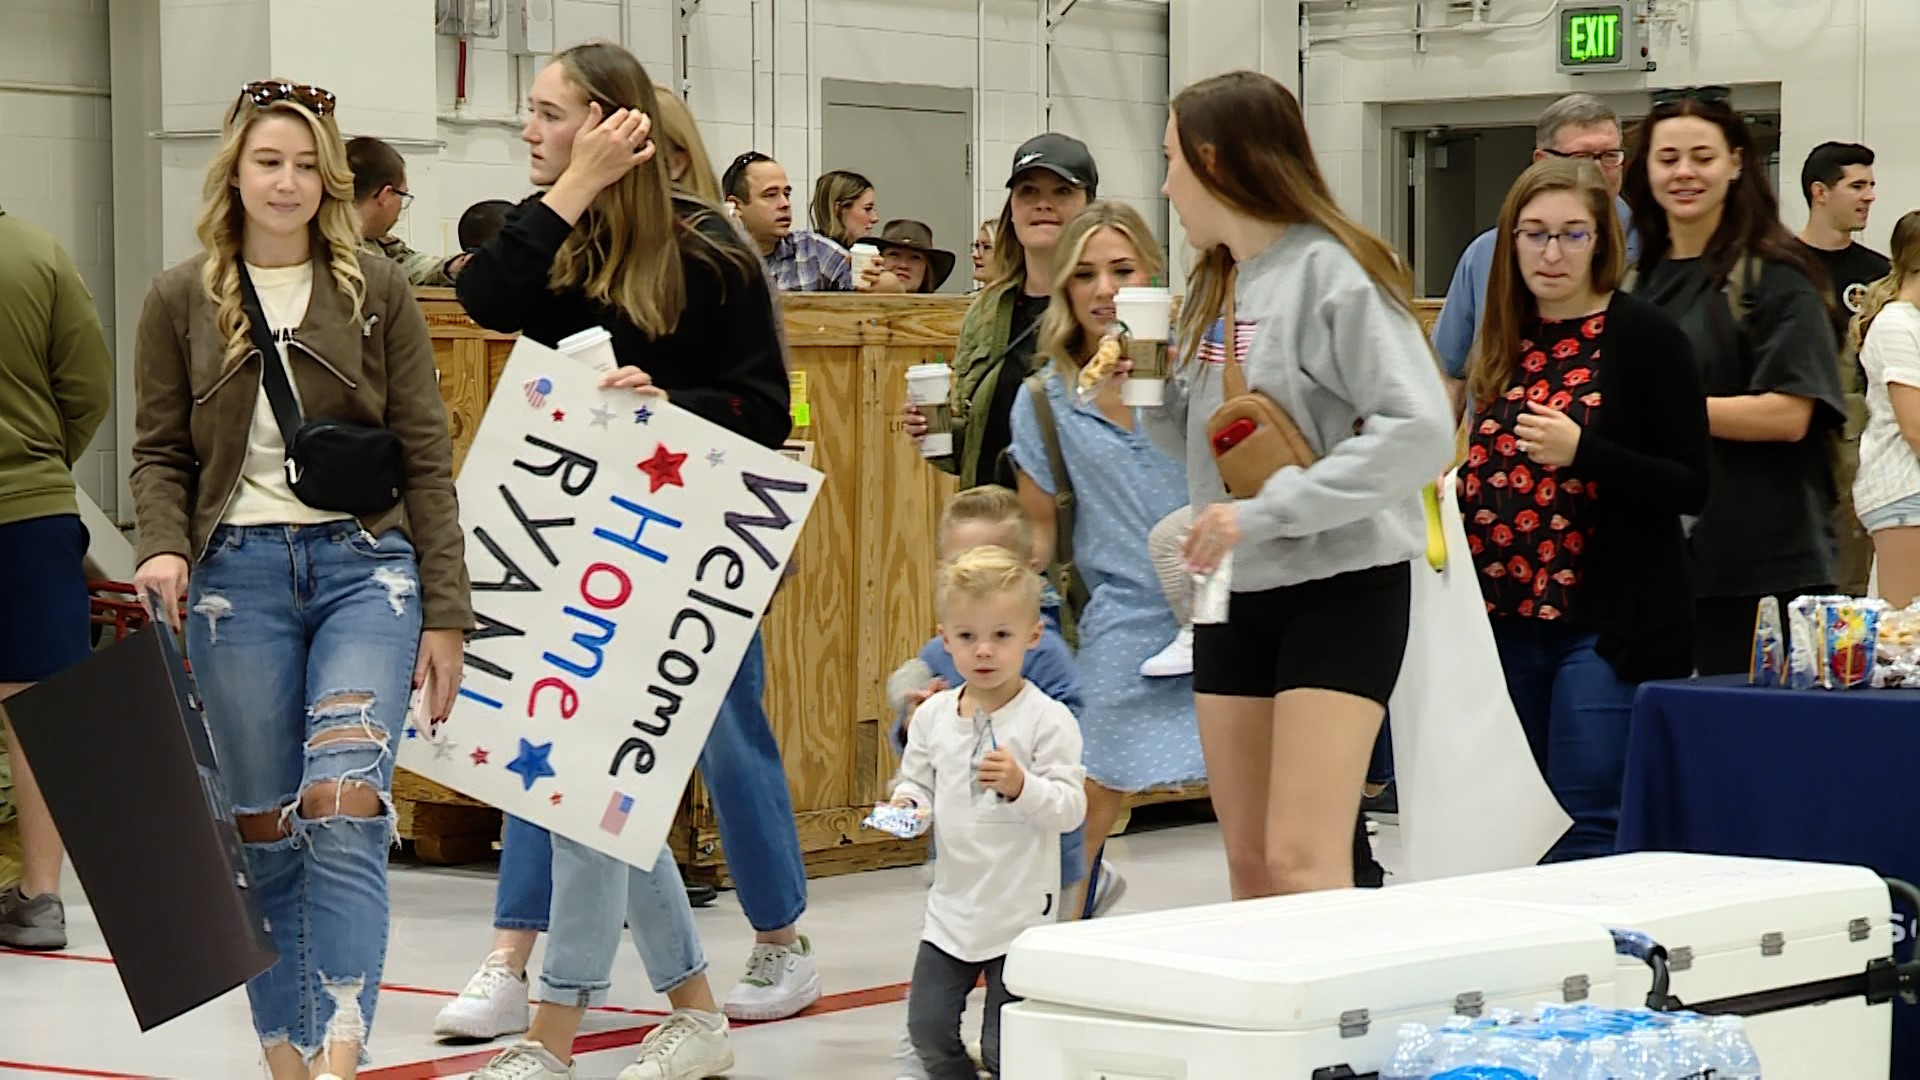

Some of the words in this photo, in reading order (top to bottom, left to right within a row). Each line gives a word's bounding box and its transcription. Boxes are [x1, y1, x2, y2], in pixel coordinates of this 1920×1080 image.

[1570, 14, 1619, 58] EXIT
[527, 494, 683, 720] Home
[608, 471, 808, 777] Welcome
